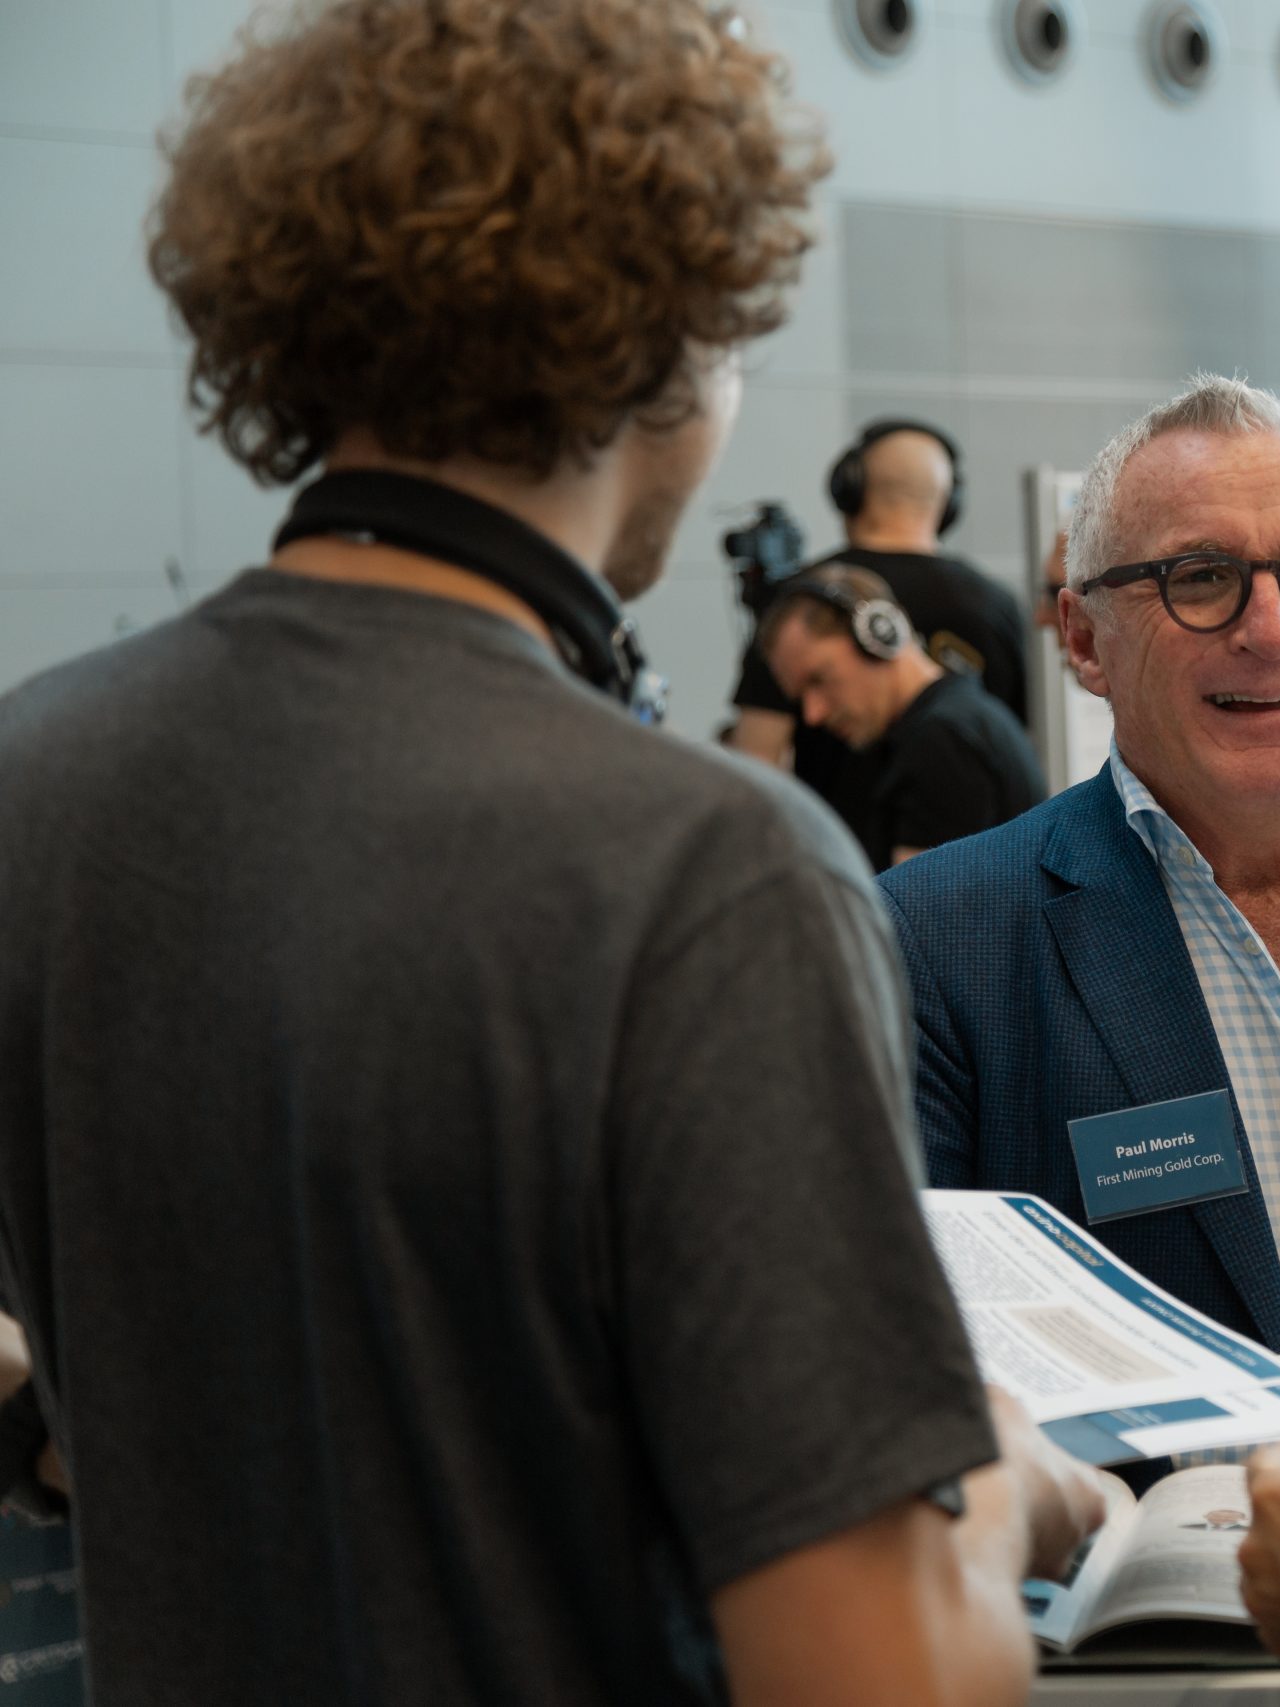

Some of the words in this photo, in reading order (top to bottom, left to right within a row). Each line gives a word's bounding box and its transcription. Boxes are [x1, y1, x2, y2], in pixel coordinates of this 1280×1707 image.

[1115, 1141, 1147, 1158] Paul
[1149, 1132, 1196, 1152] Morris
[1096, 1174, 1121, 1187] First
[1123, 1164, 1163, 1181] Mining
[1164, 1158, 1192, 1172] Gold
[1193, 1153, 1225, 1168] Corp.
